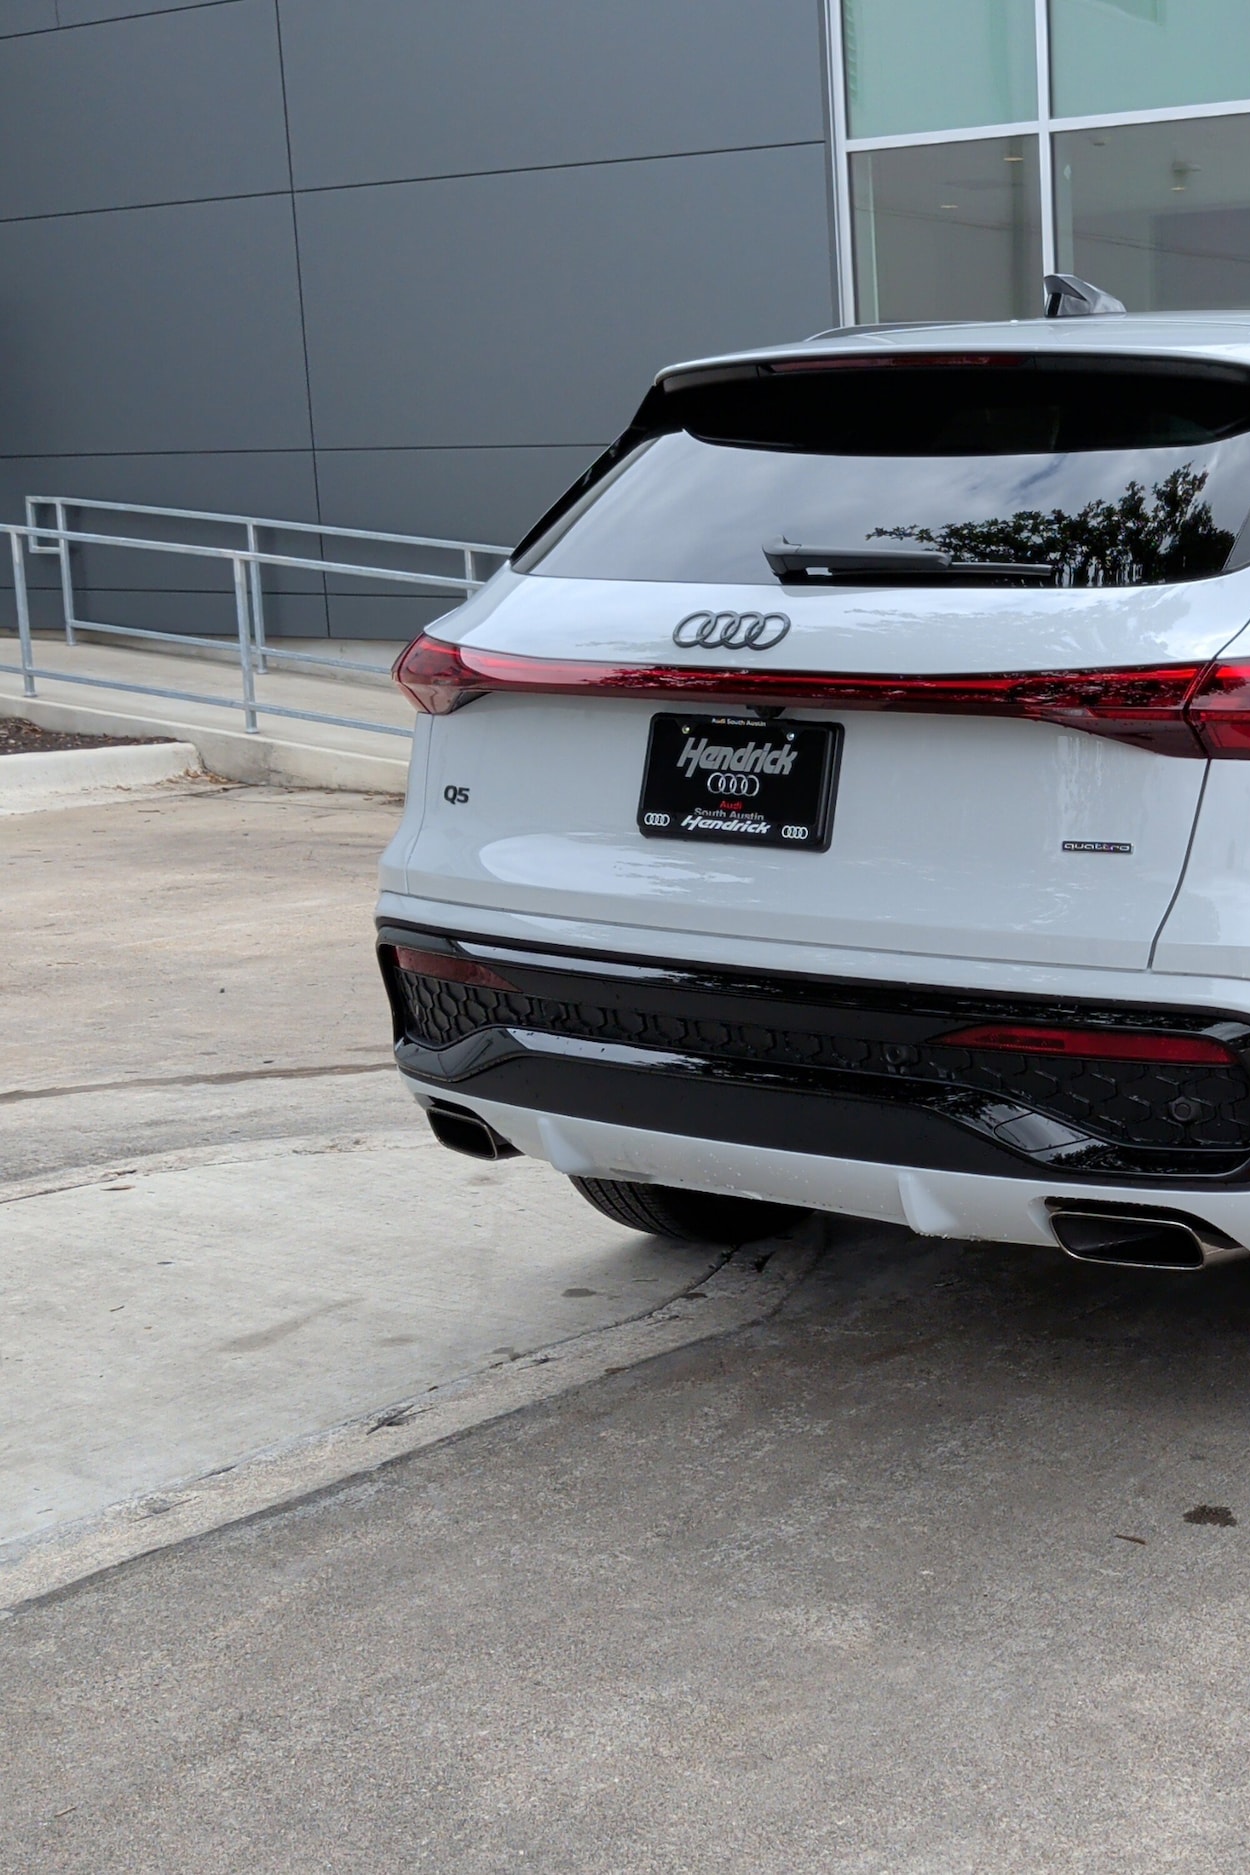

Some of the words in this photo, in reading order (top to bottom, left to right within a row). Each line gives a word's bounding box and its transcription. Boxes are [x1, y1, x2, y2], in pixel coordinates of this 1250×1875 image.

[727, 718, 746, 726] South
[676, 737, 798, 777] Hendrick
[444, 785, 470, 805] Q5
[720, 801, 742, 809] Audi
[694, 807, 726, 817] South
[729, 811, 764, 820] Austin
[681, 815, 771, 833] Hendrick
[1064, 842, 1130, 851] quattro
